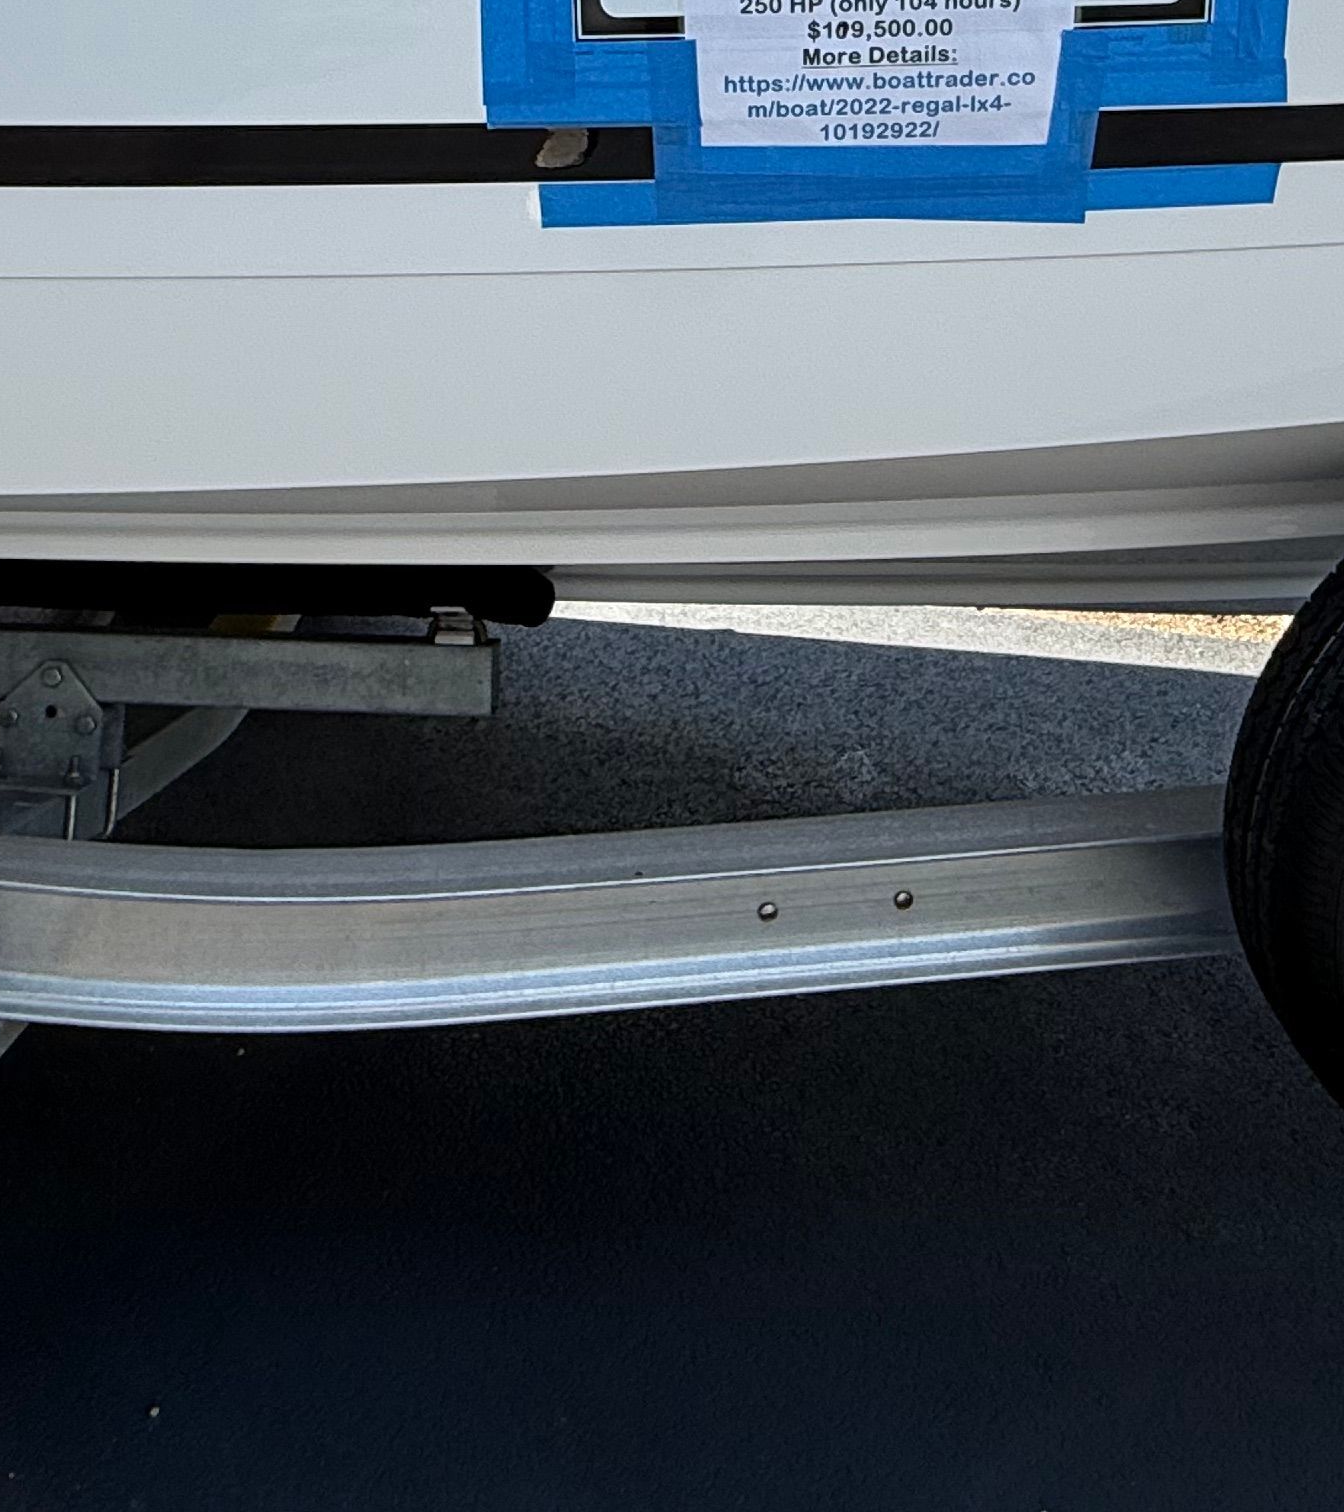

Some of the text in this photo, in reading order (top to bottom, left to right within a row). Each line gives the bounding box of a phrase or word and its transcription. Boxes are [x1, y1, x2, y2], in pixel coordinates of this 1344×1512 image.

[802, 44, 958, 66] More Details:
[723, 69, 1036, 98] https://www.boattrader.co
[747, 94, 1013, 120] m/boat/2022-regal-lx4-
[818, 120, 940, 142] 10192922/
